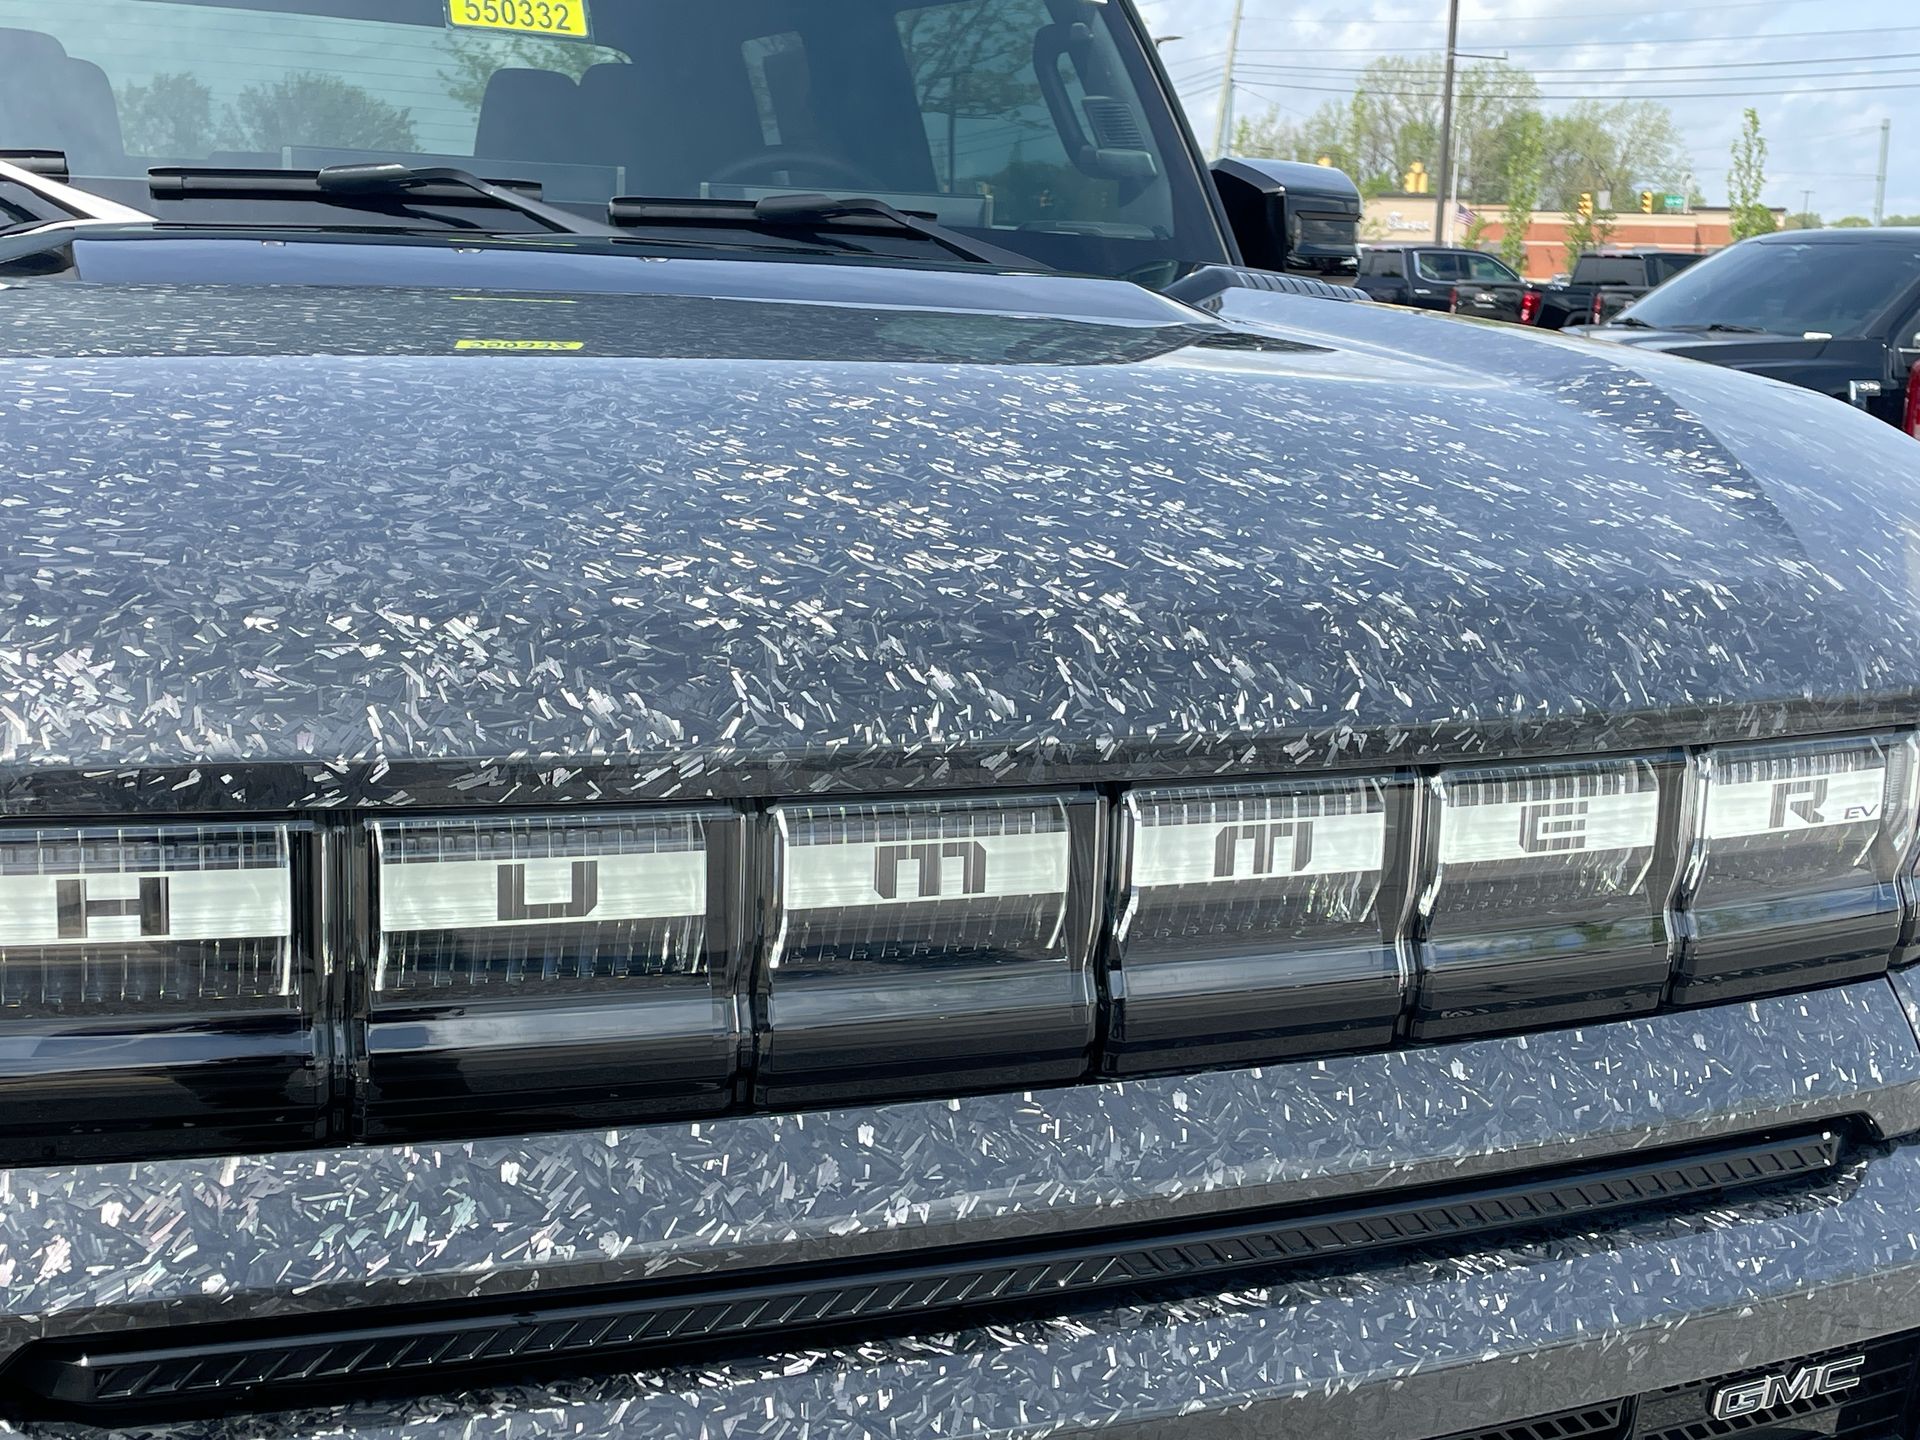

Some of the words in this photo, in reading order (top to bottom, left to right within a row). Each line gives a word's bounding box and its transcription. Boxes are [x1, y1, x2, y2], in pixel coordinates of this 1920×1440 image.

[465, 0, 571, 30] 550332
[56, 778, 1828, 938] HUMMER
[1844, 803, 1878, 819] EV
[1713, 1355, 1866, 1421] GMC
